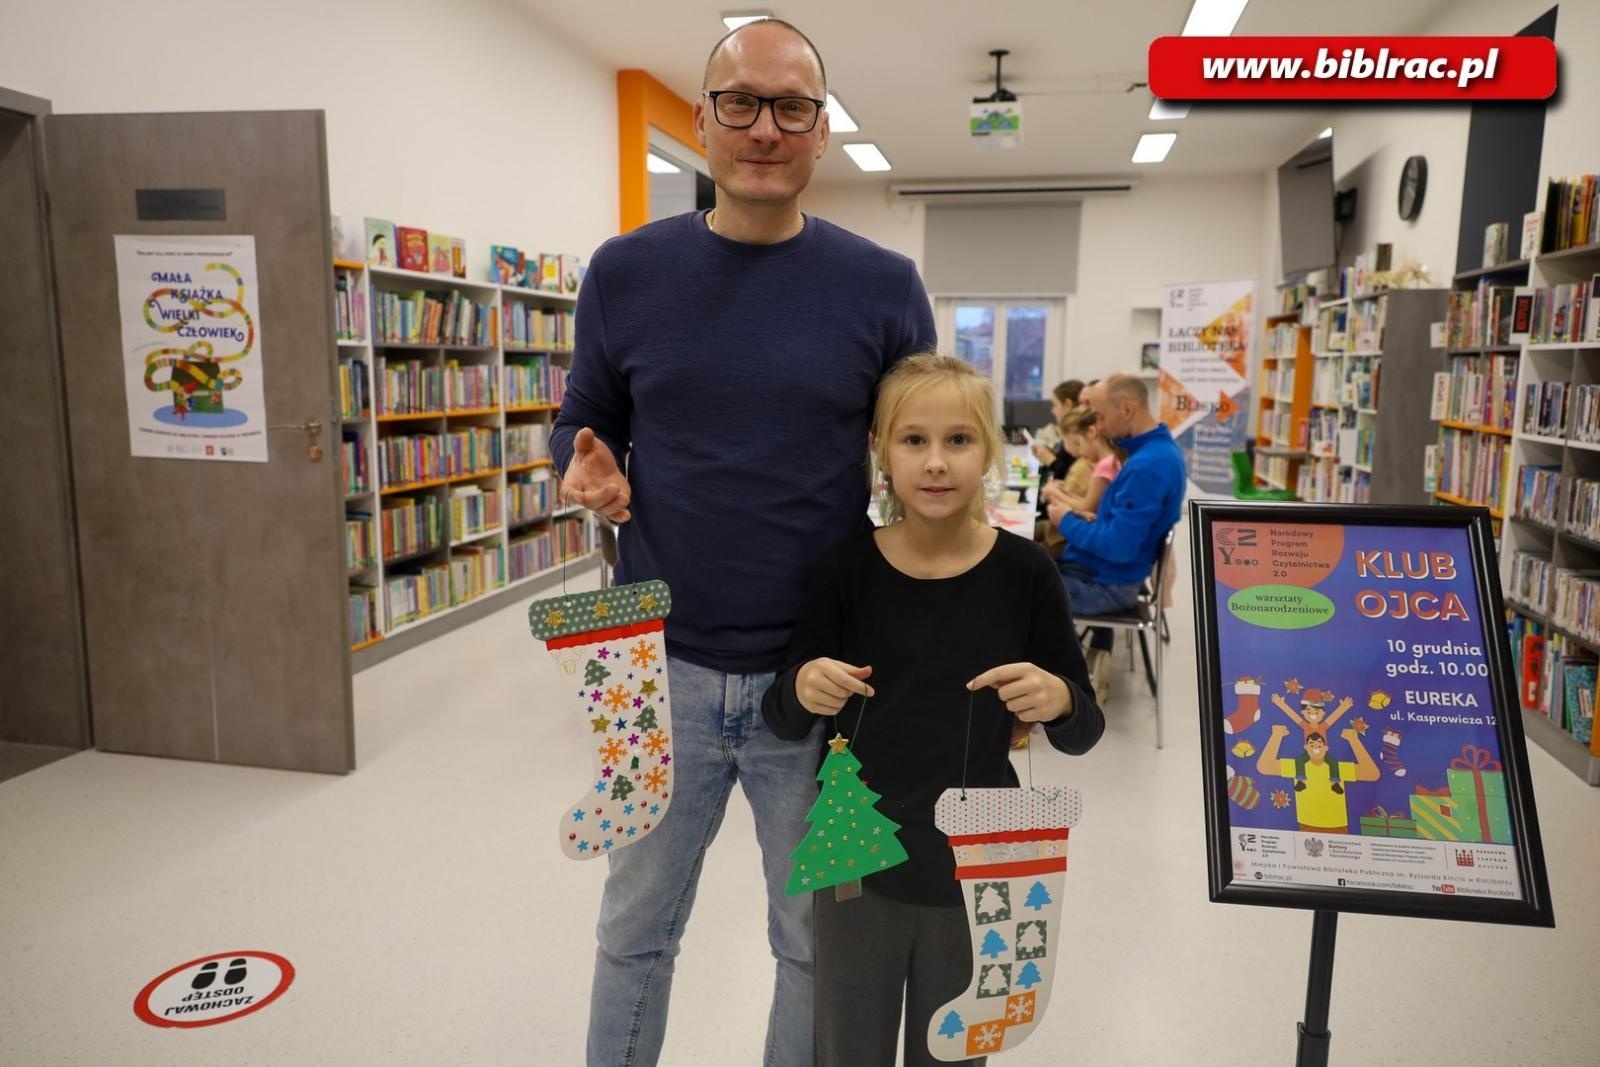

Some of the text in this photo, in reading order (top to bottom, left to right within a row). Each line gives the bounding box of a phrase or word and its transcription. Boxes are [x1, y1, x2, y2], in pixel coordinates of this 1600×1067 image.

[151, 272, 192, 283] MAŁA
[177, 326, 245, 342] CZŁOWIEK
[1270, 529, 1314, 538] Narodowy
[1271, 540, 1308, 548] Program
[1271, 550, 1309, 558] Rozwoju
[1272, 560, 1330, 569] Czytelnictwa
[1356, 550, 1457, 580] KLUB
[1273, 570, 1288, 578] 2.0
[1255, 594, 1304, 604] warsztaty
[1355, 589, 1470, 621] OJCA
[1231, 602, 1330, 615] Bożonarodzeniowe
[1387, 640, 1482, 658] 10 grudnia
[1386, 660, 1488, 677] godz. 10.00
[1405, 690, 1479, 707] EUREKA
[1390, 711, 1404, 721] ul.
[1407, 712, 1483, 726] Kasprowicza
[1323, 866, 1358, 875] Biblioteka
[1360, 869, 1394, 878] Publiczna
[182, 986, 245, 1002] ODSTĘP
[164, 995, 255, 1016] ZACHOWAJ
